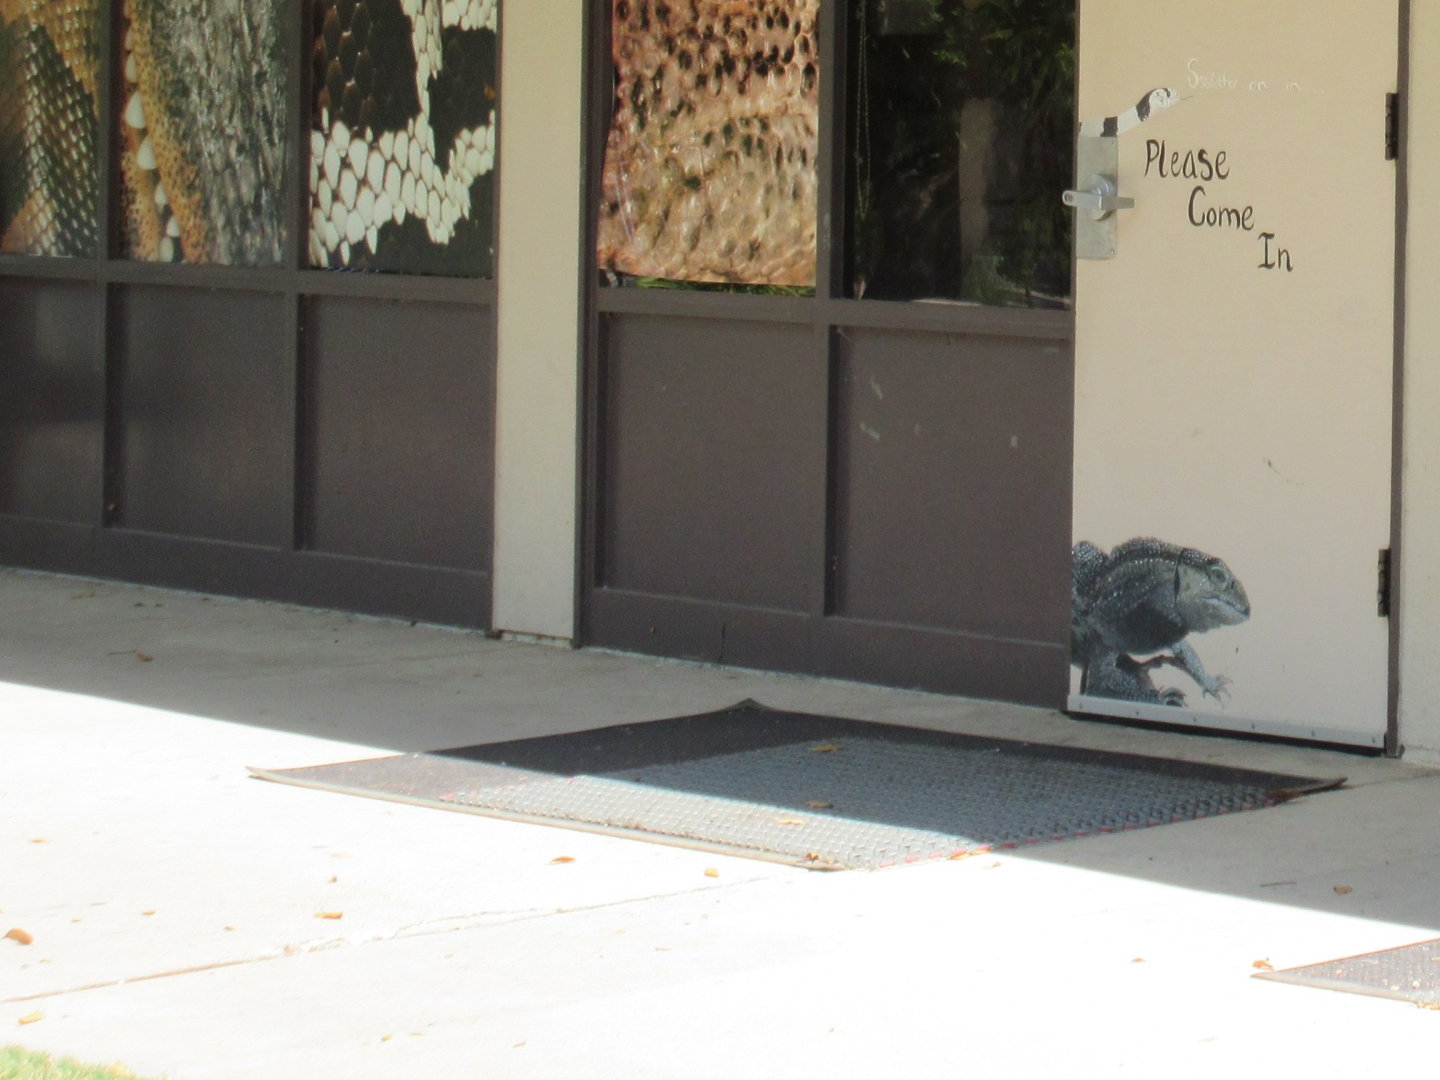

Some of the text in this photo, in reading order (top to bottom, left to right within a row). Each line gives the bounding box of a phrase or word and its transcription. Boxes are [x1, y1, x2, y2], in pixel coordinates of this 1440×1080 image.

[1144, 139, 1230, 181] Please
[1188, 185, 1255, 230] Come
[1257, 231, 1293, 272] In
